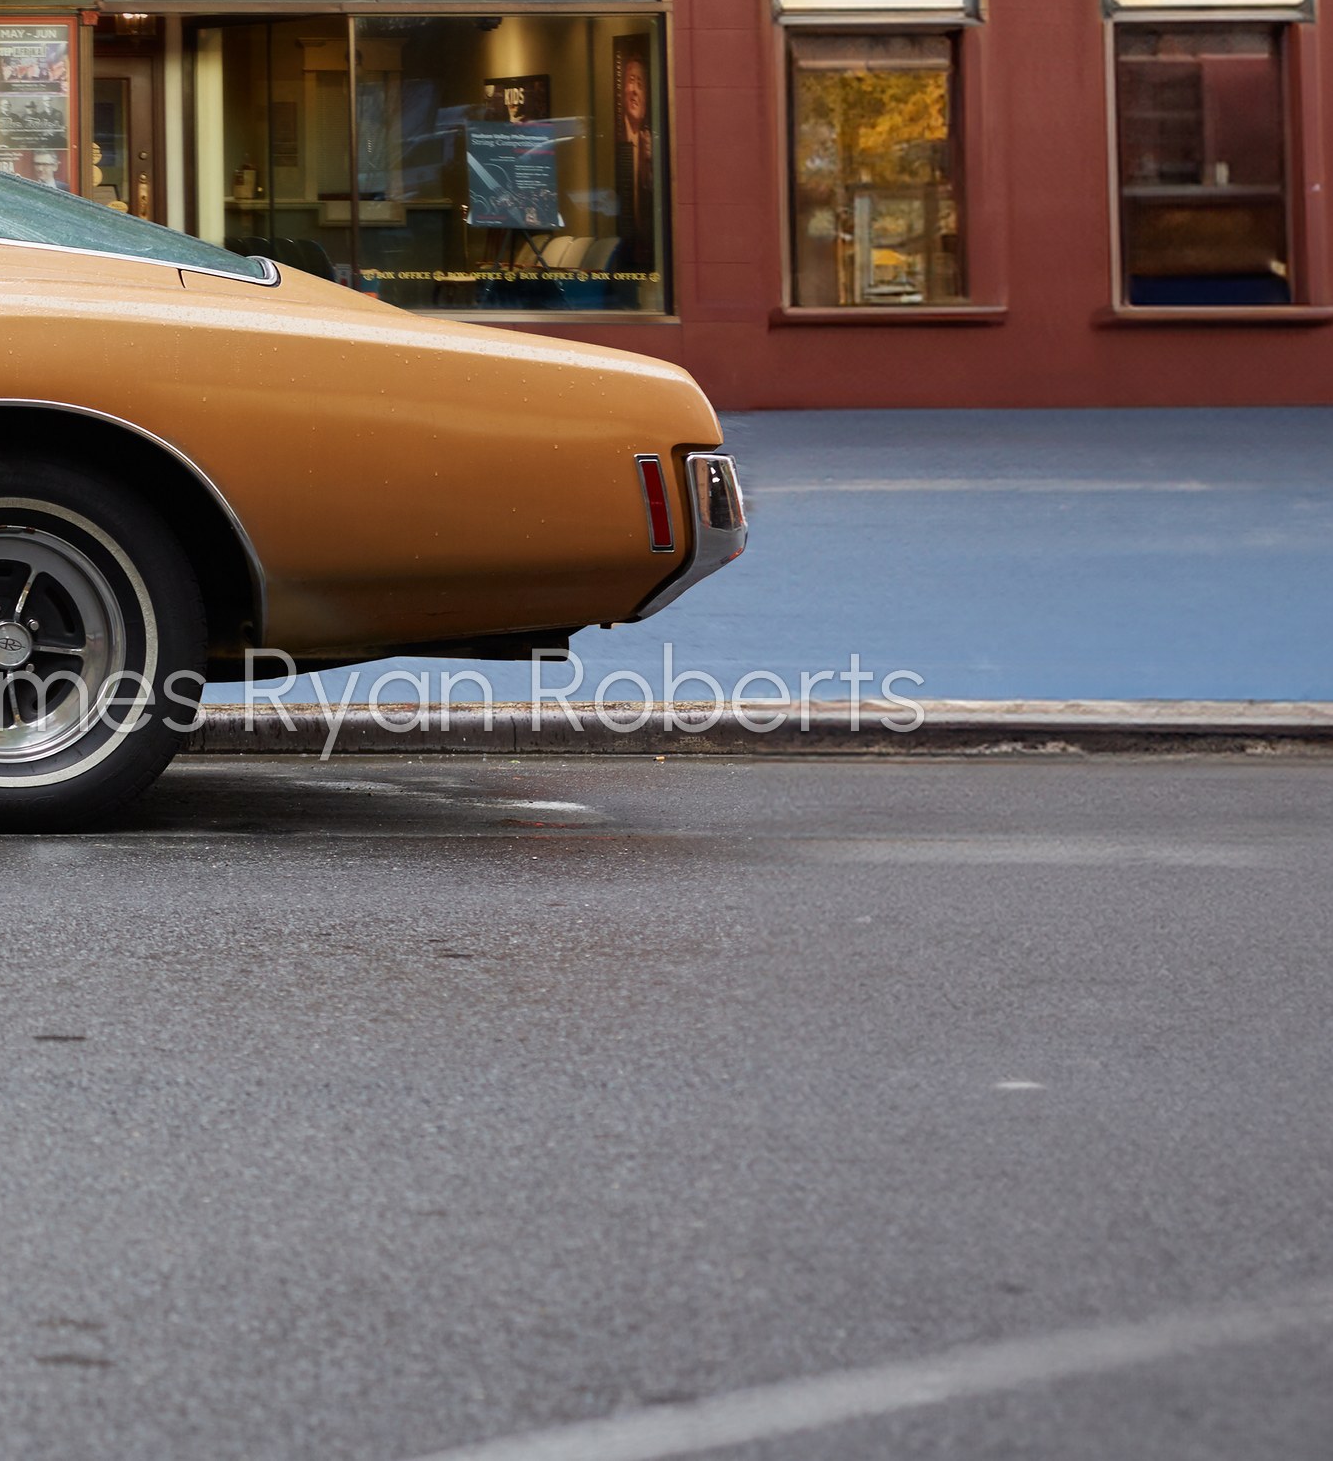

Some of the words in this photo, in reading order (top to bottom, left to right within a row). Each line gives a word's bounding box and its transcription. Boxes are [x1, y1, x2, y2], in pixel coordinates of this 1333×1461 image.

[0, 29, 26, 38] MAY
[32, 29, 57, 38] JUN
[504, 87, 525, 106] KIDS
[519, 272, 538, 280] BOX
[541, 272, 574, 280] OFFICE
[591, 272, 611, 280] BOX
[613, 272, 647, 280] OFFICE
